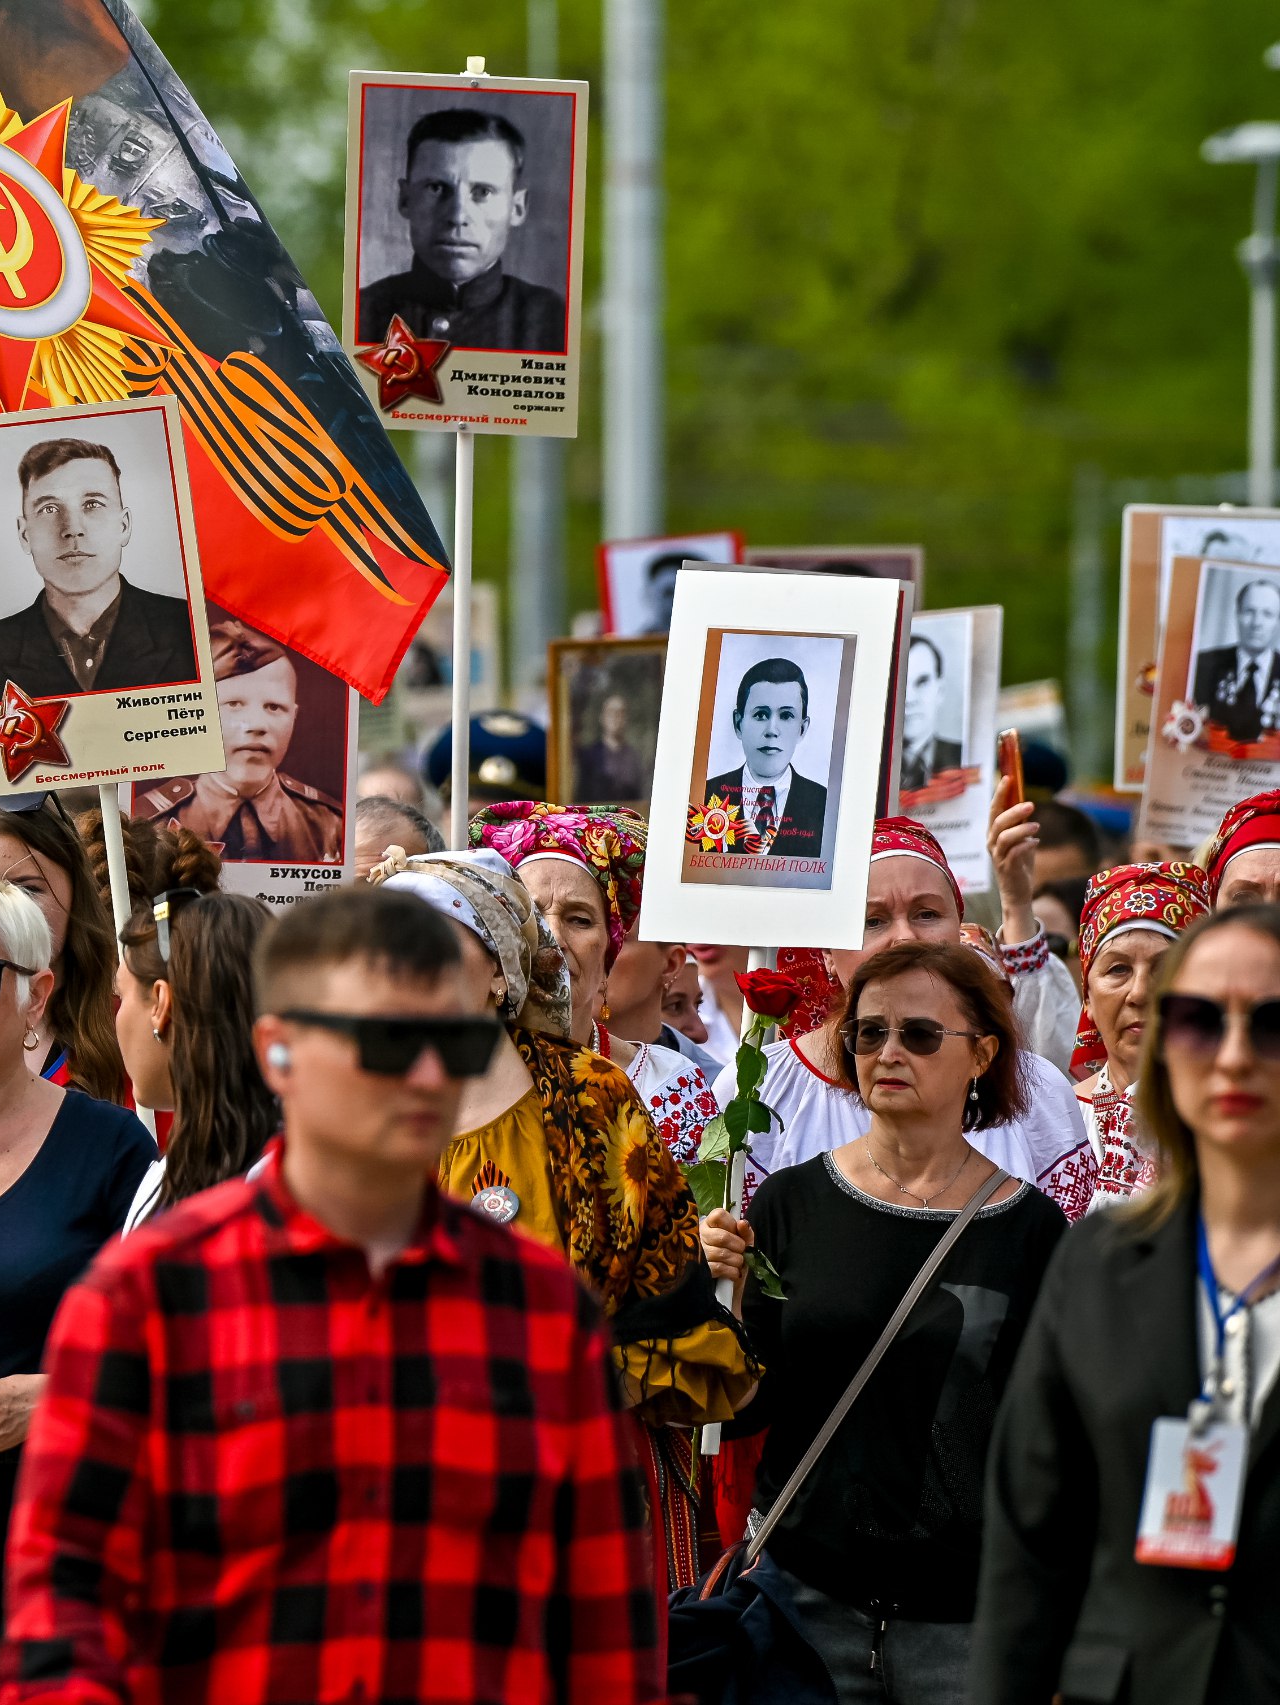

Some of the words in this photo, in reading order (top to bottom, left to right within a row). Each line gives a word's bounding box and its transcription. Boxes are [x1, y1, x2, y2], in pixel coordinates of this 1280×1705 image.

[520, 358, 567, 371] Иван
[450, 369, 566, 386] Дмитриевич
[467, 385, 566, 400] Коновалов
[512, 403, 566, 413] сержант
[391, 410, 490, 424] Бессмертный
[493, 416, 528, 425] полк
[116, 691, 203, 709] Животягин
[167, 708, 205, 721] Пётр
[123, 724, 207, 743] Сергеевич
[35, 765, 129, 784] Бессмертный
[132, 762, 166, 773] полк
[689, 854, 786, 872] БЕССМЕРТНЫЙ
[788, 860, 828, 874] ПОЛК
[269, 867, 342, 879] БУКУСОВ
